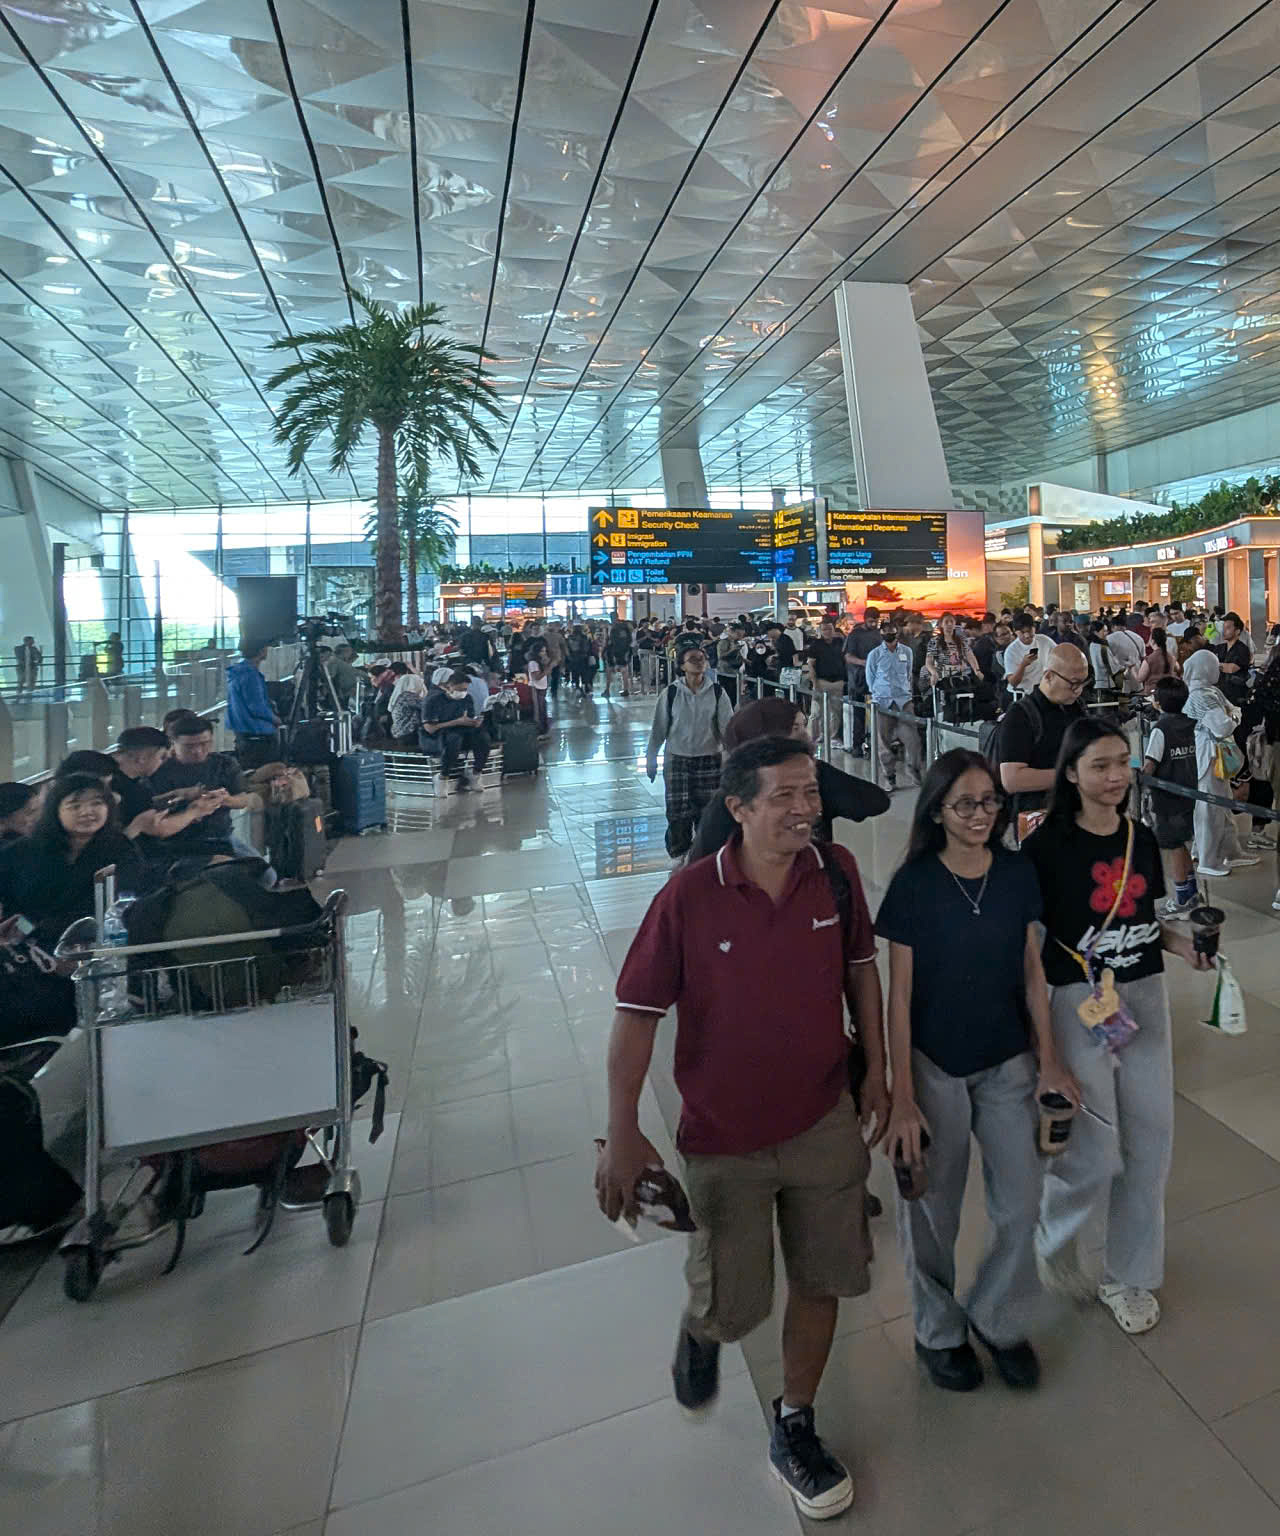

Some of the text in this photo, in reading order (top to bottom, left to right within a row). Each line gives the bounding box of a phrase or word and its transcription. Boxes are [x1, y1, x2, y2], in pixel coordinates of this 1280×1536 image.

[641, 510, 733, 519] Pemeriksaan Keamanan
[833, 512, 921, 523] Keberangkatan Internasional
[641, 521, 700, 531] Security Check
[833, 523, 909, 532] International Departures
[627, 532, 654, 542] Imigrasi
[842, 537, 853, 546] 10
[627, 540, 668, 549] Immigration
[627, 551, 676, 560] Pengembalian
[855, 551, 872, 560] Uang
[844, 558, 870, 567] Changer
[645, 568, 665, 576] Toilet
[859, 567, 887, 576] Maskapai
